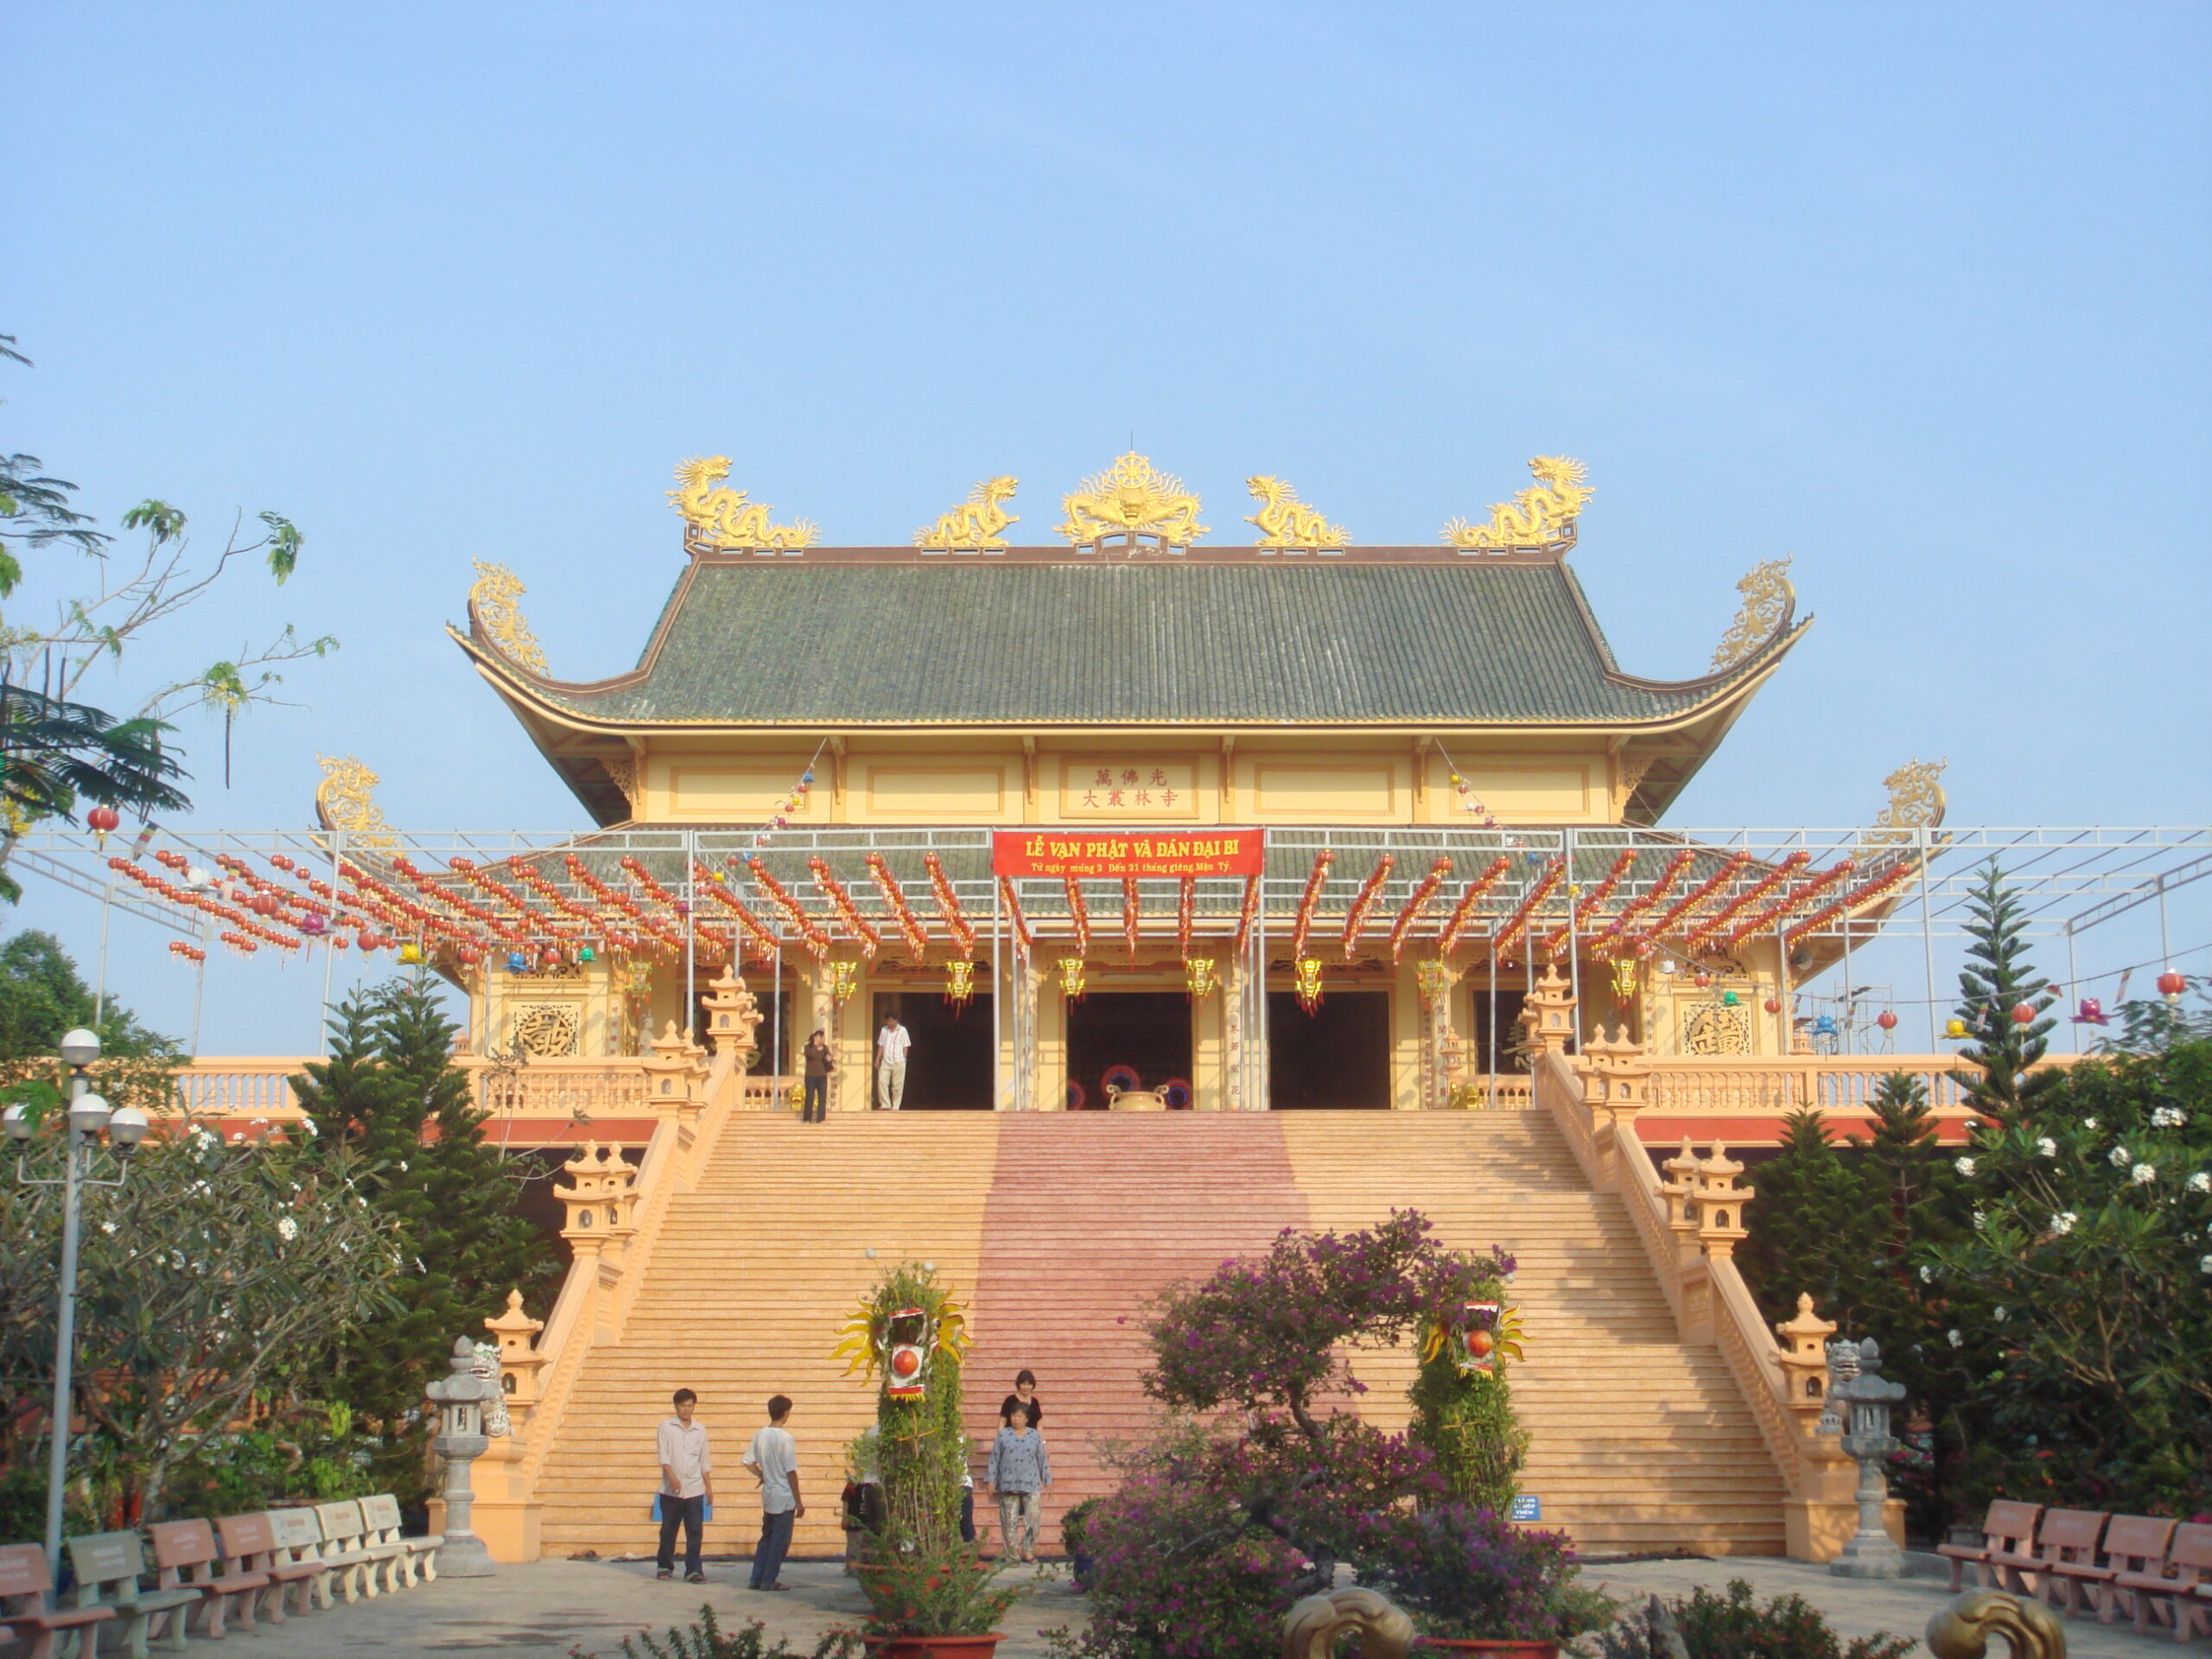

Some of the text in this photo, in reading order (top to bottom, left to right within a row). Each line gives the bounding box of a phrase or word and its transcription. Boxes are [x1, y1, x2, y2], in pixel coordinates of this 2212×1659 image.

[1095, 768, 1167, 787] 萬佛光
[1083, 788, 1179, 808] 大叢林寺
[1025, 835, 1045, 857] LỄ
[1049, 842, 1081, 860] VẠN
[1085, 839, 1128, 861] PHẬT
[1192, 840, 1221, 859] ĐẠI
[1223, 839, 1239, 855] BI
[1096, 863, 1103, 872] 2
[1128, 863, 1139, 872] 21
[1142, 861, 1167, 874] tháng
